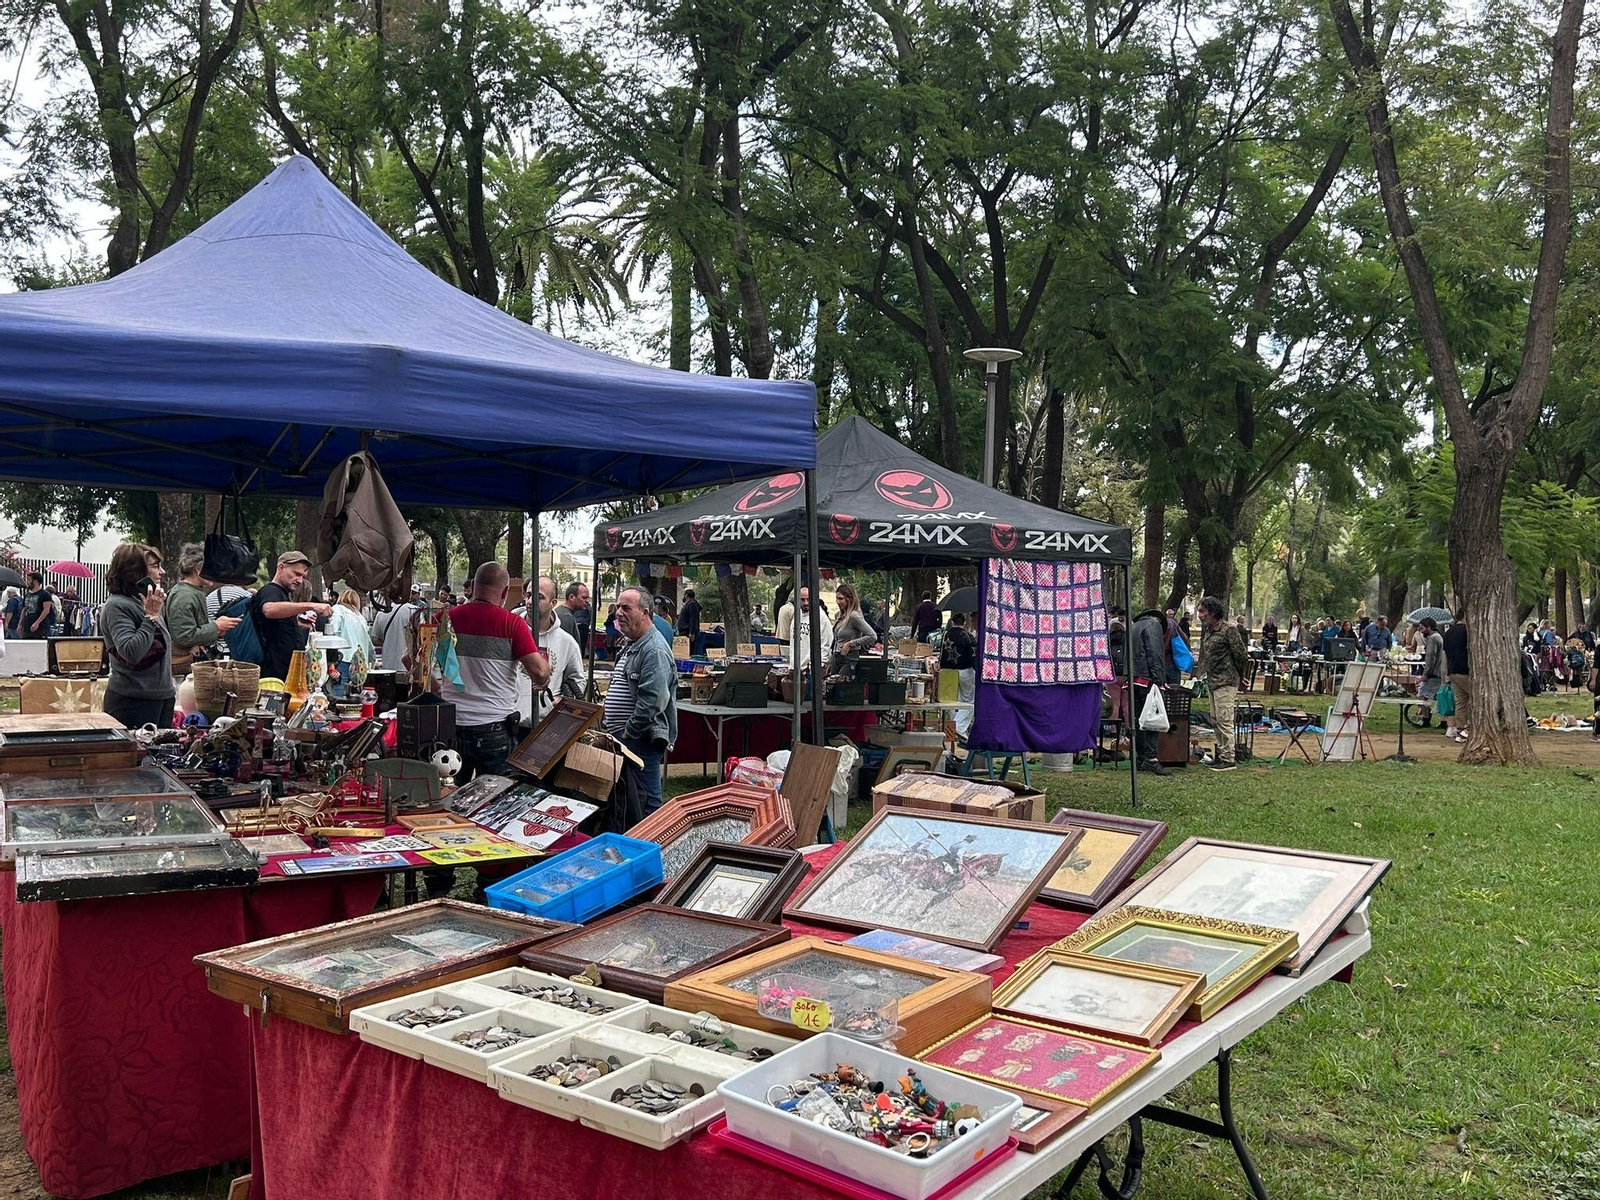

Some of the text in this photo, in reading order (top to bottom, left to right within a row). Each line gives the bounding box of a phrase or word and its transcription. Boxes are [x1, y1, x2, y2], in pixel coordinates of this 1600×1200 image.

[621, 525, 676, 548] 24MX
[709, 518, 776, 541] 24MX
[868, 522, 969, 546] 24MX
[1025, 530, 1111, 554] 24MX
[803, 1013, 820, 1028] 1€
